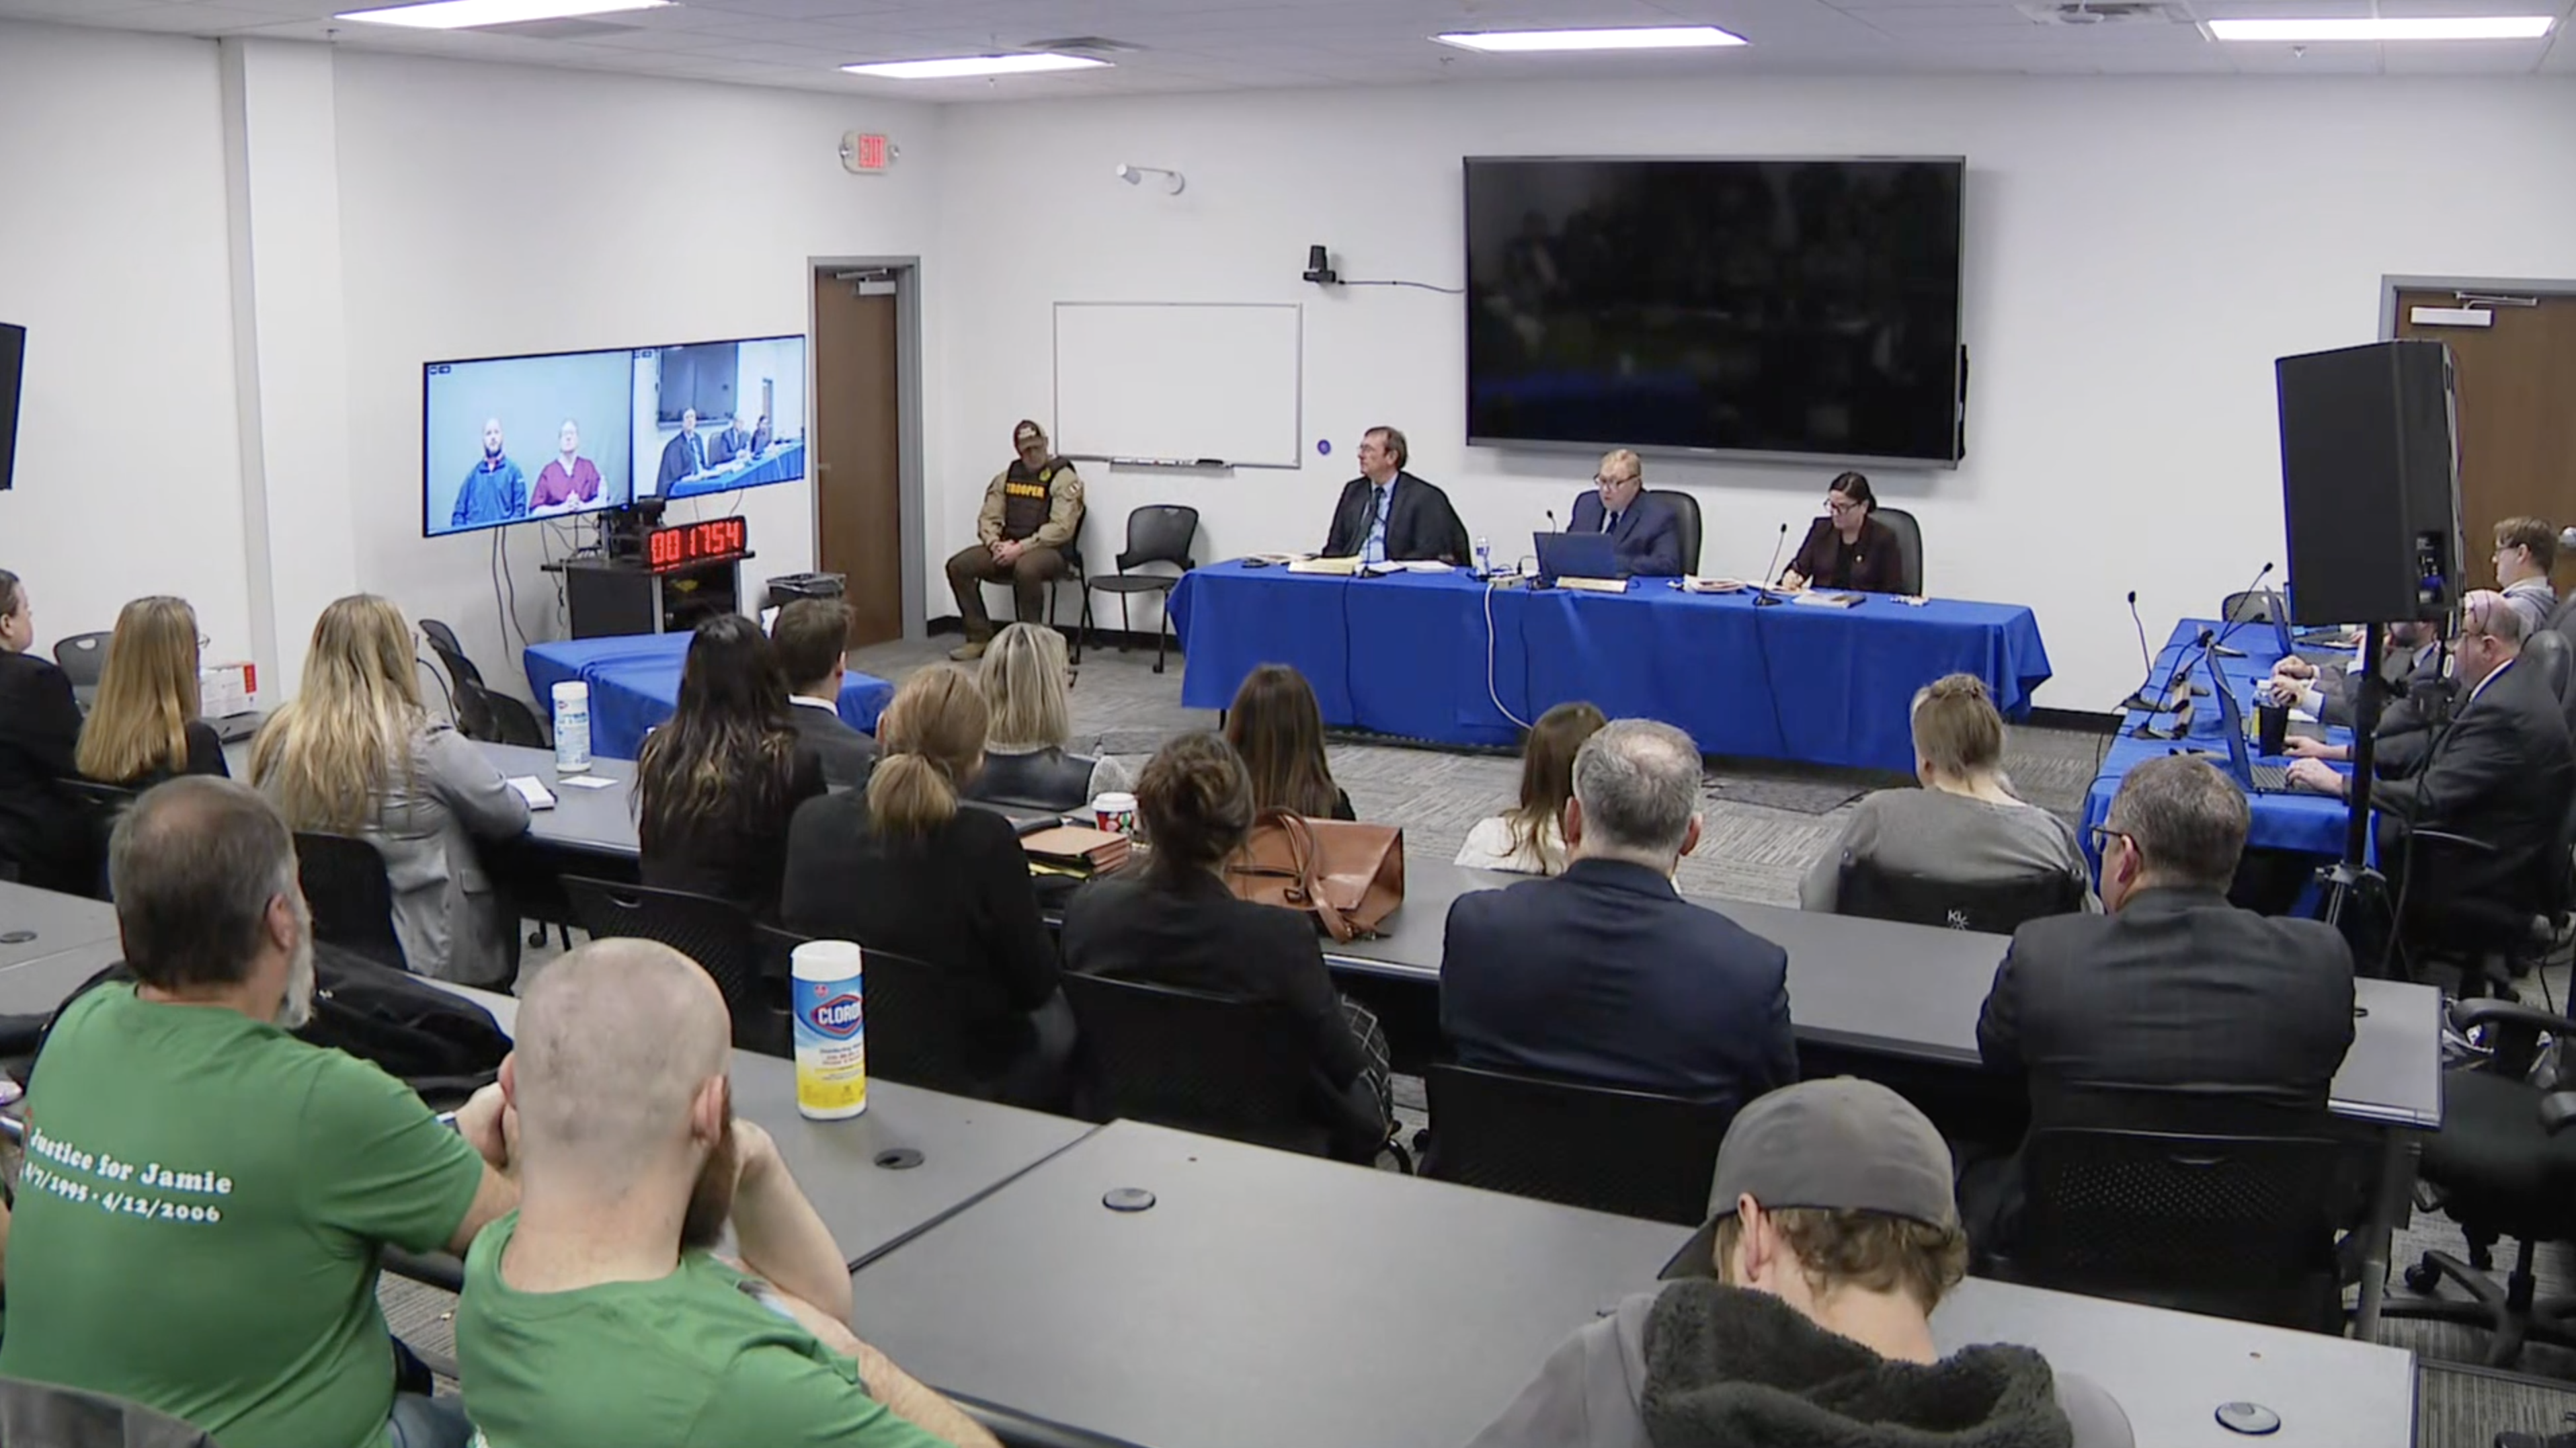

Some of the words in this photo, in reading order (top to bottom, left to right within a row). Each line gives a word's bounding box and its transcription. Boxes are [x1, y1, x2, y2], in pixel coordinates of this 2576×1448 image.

[1006, 481, 1045, 498] TROOPER
[818, 1000, 862, 1026] CLORO
[30, 1127, 94, 1170] Justice
[96, 1153, 134, 1180] for
[140, 1162, 233, 1195] Jamie
[102, 1191, 221, 1223] 4/12/2006
